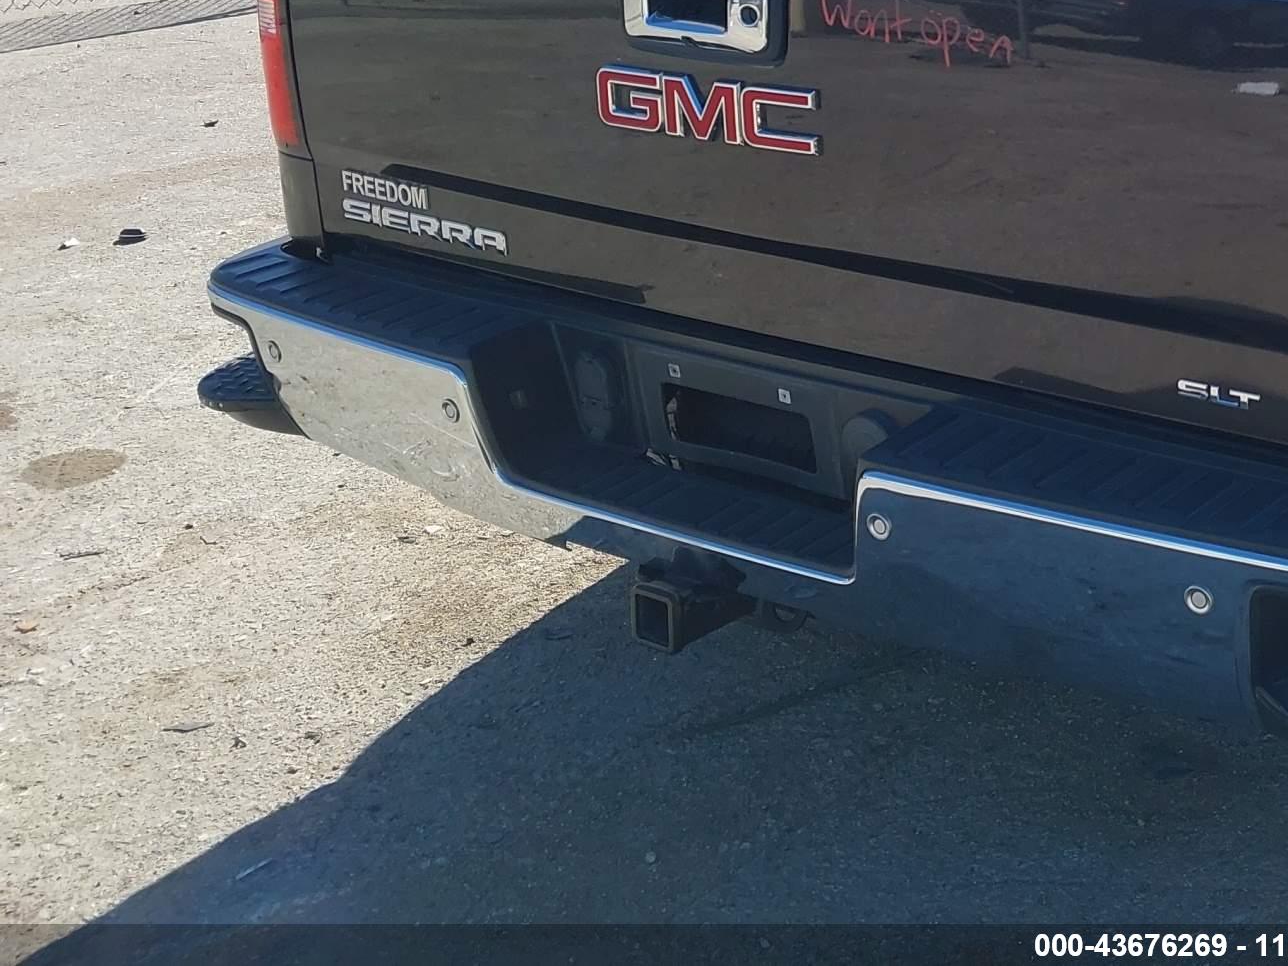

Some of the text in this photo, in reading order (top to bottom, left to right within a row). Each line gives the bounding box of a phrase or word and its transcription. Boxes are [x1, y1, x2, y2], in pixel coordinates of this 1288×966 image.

[920, 9, 1014, 67] open
[596, 66, 822, 156] GMC
[341, 170, 428, 210] FREEDOM
[342, 198, 508, 257] SIERRA
[1177, 379, 1261, 410] SLT
